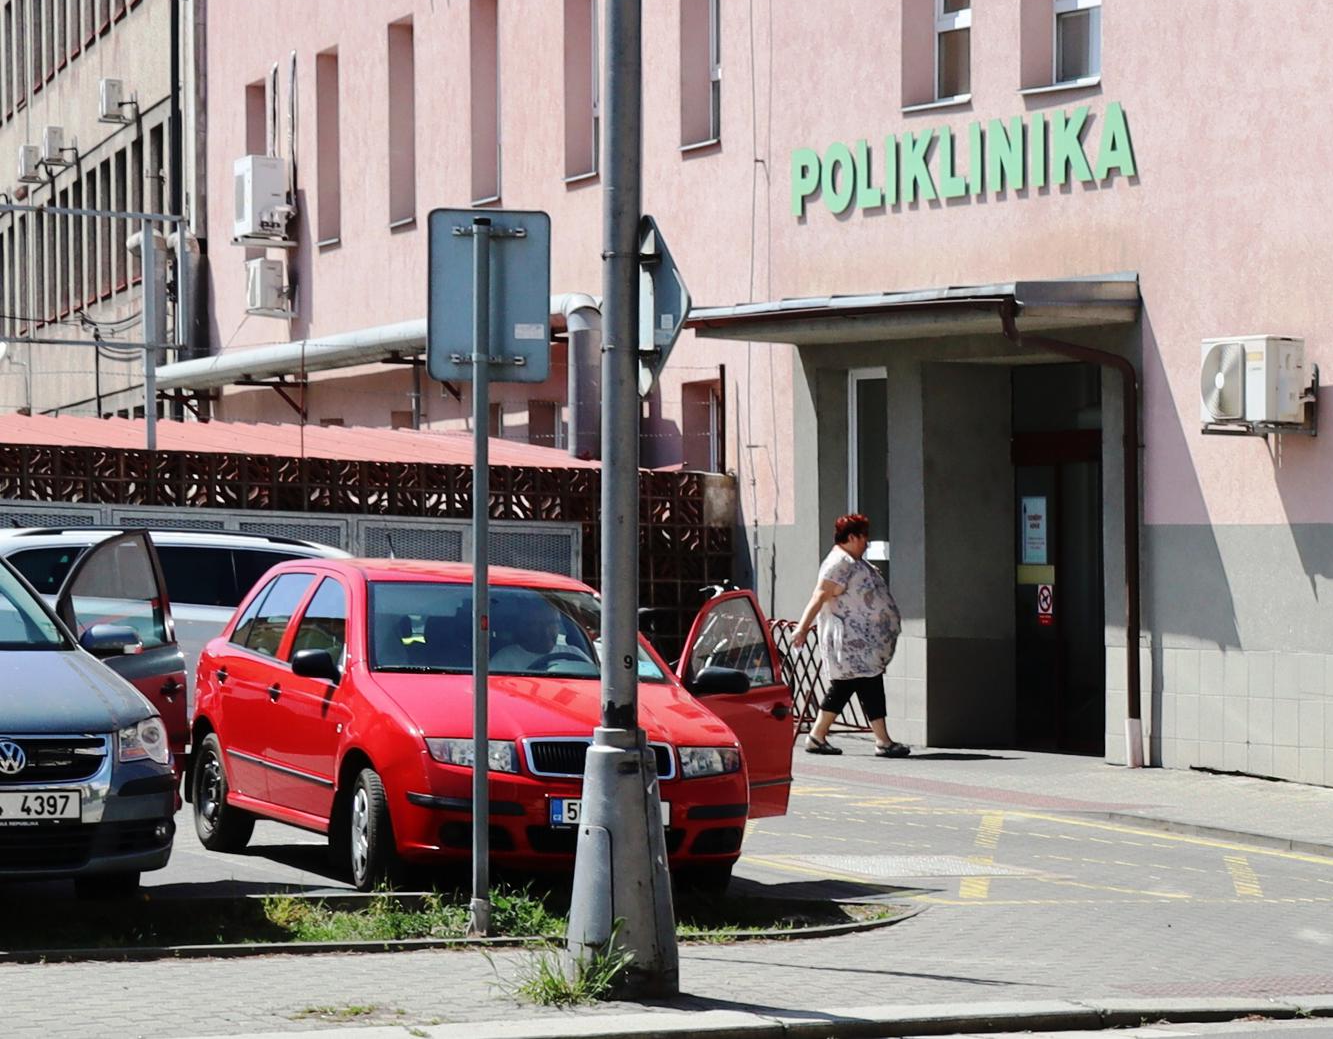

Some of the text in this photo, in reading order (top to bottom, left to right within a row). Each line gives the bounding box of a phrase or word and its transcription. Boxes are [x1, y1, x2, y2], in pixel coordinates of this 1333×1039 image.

[791, 101, 1136, 216] POLIKLINIKA
[623, 654, 633, 670] 9
[21, 795, 70, 816] 4397
[567, 803, 582, 820] 5
